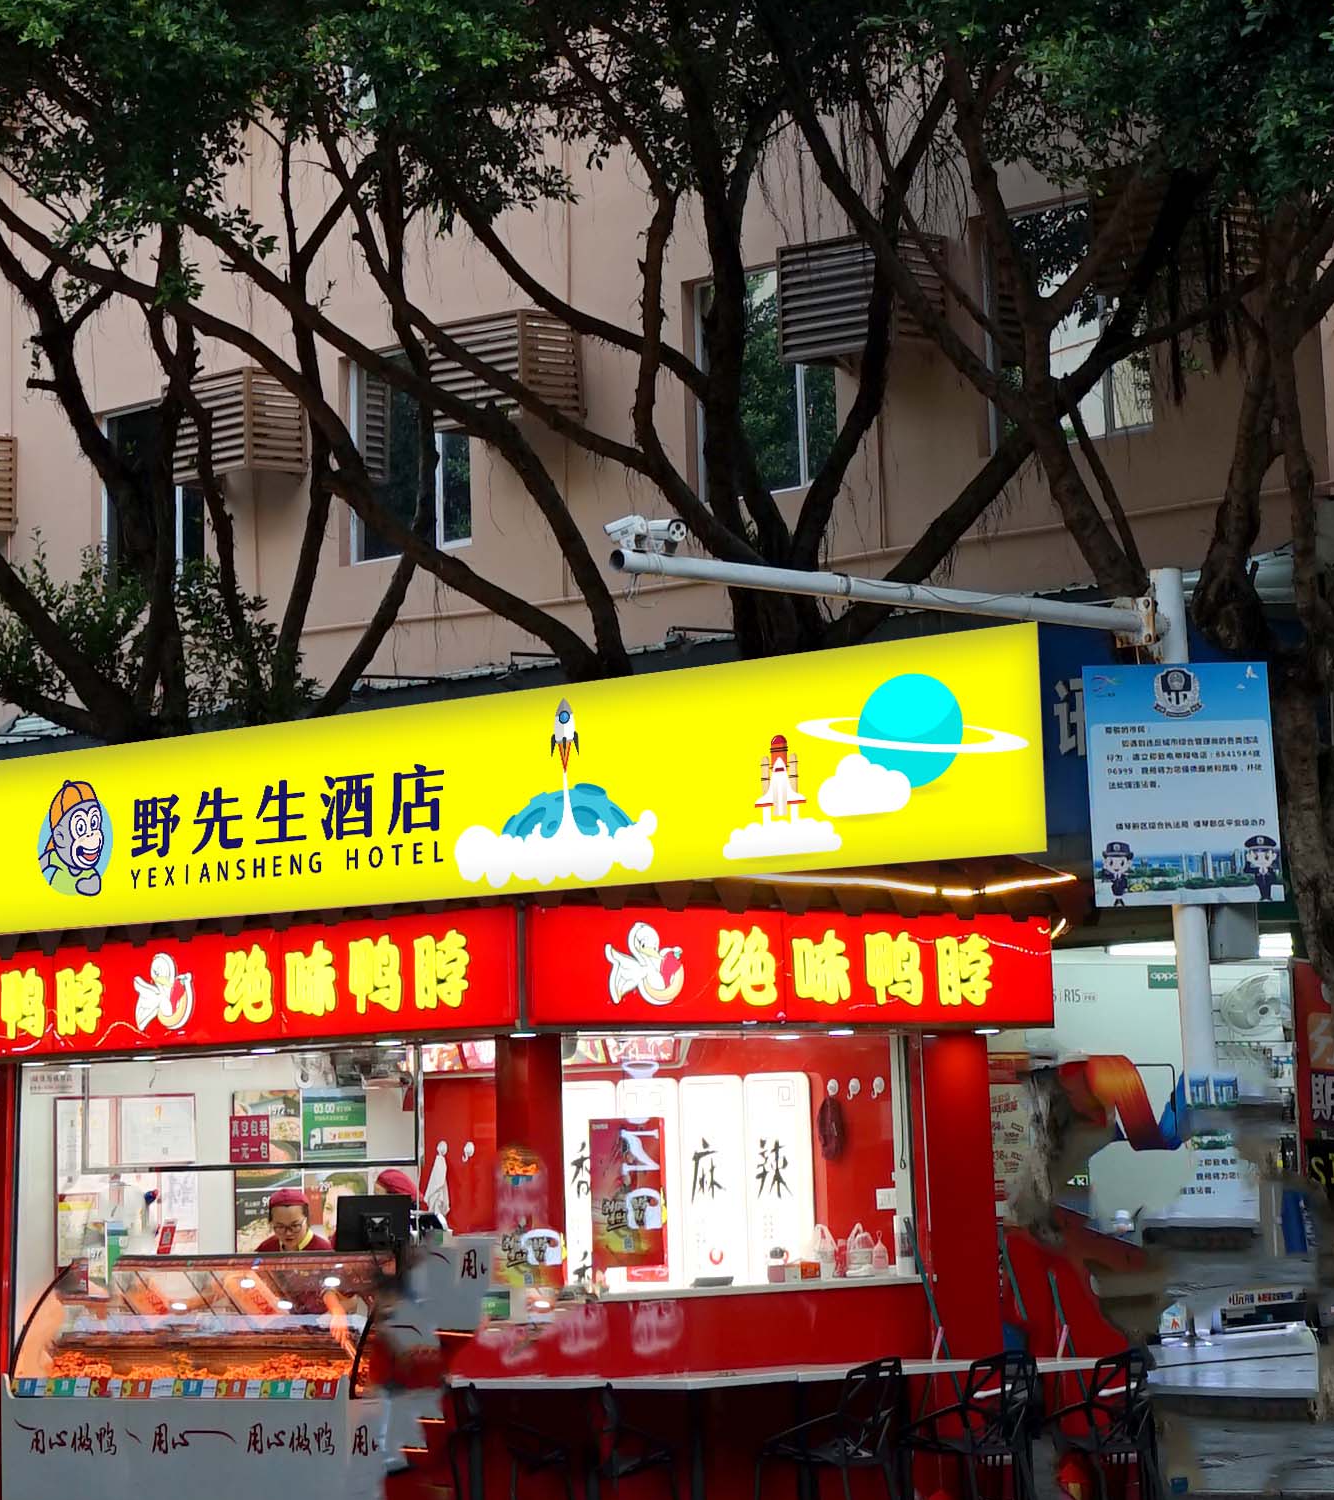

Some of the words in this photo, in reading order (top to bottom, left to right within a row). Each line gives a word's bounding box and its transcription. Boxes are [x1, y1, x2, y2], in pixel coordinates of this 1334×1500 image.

[131, 764, 444, 857] 野先生酒店
[131, 851, 322, 889] YEXIANSHENG
[347, 840, 444, 870] HOTEL
[223, 929, 470, 1023] 绝味鸭脖
[718, 925, 993, 1007] 绝味鸭脖
[29, 1421, 117, 1457] 用心做鸭
[246, 1422, 335, 1457] 用心做鸭
